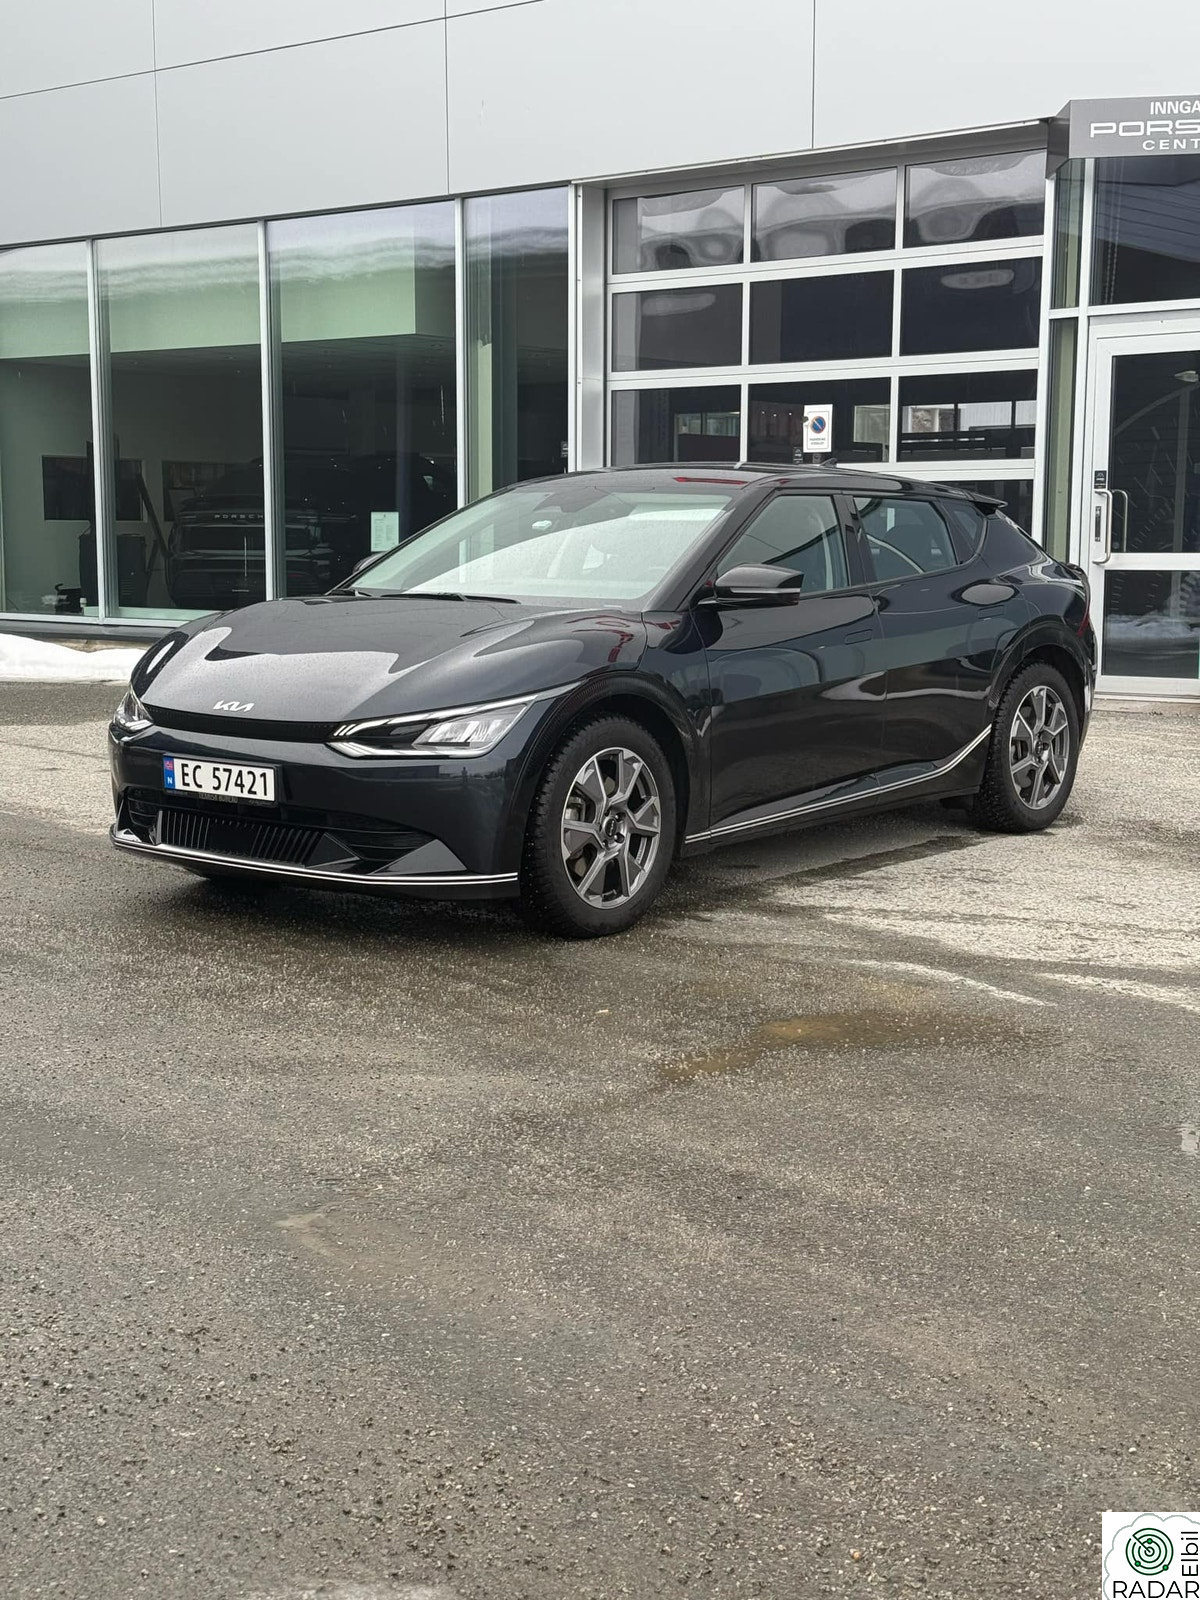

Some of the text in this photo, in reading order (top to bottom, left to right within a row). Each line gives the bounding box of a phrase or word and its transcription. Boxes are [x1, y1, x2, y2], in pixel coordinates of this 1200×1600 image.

[1090, 119, 1200, 138] PORS
[1142, 139, 1200, 151] CENT
[213, 700, 255, 712] KIA
[181, 763, 268, 797] EC 57421
